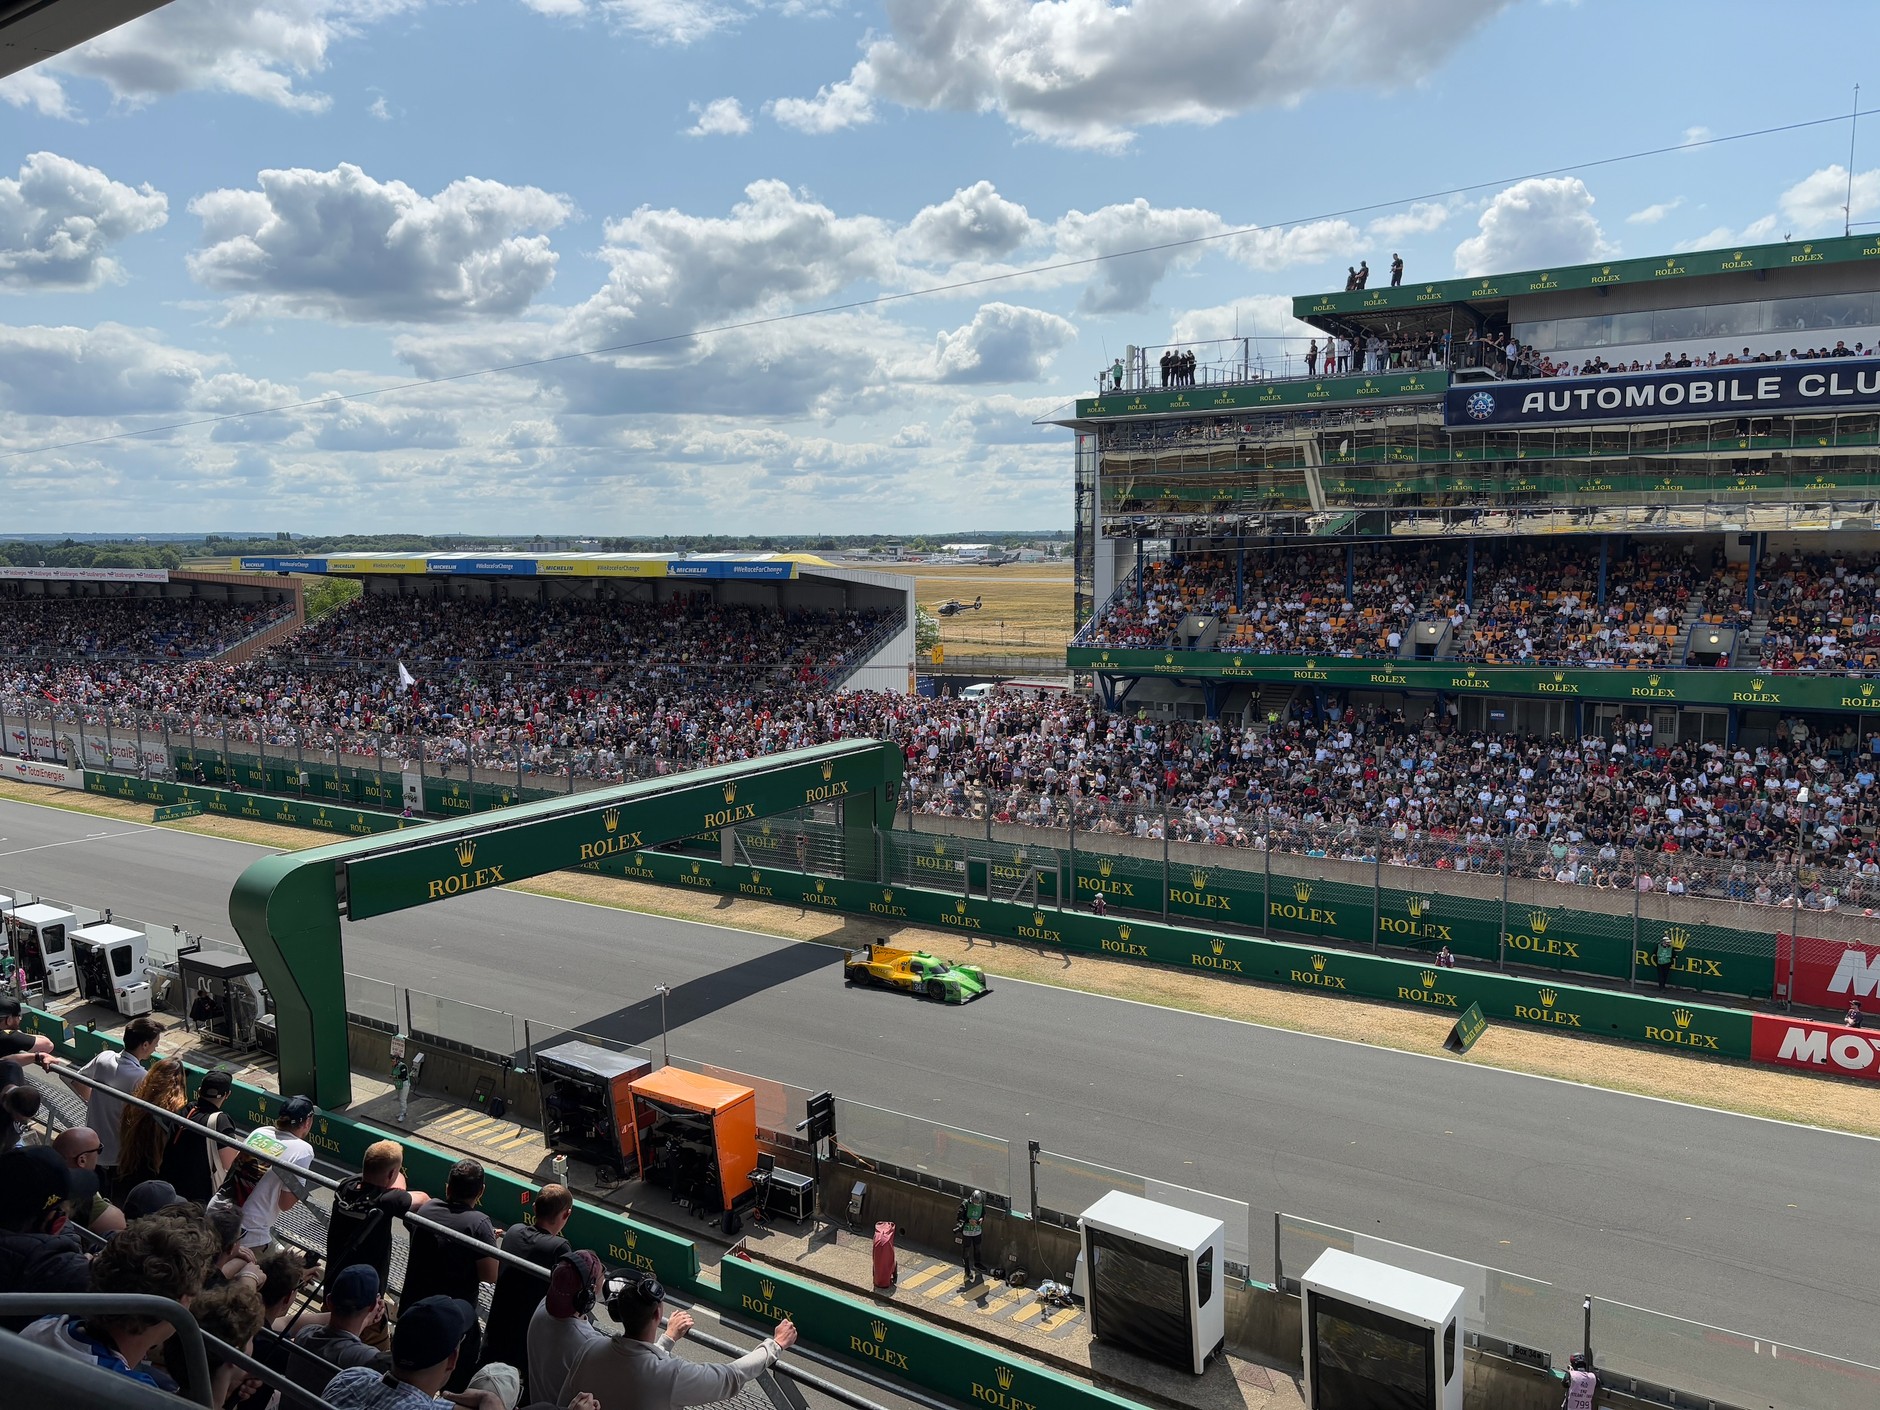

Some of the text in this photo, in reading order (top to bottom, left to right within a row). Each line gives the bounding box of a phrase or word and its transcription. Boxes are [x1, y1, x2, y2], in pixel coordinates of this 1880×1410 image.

[1792, 254, 1823, 262] ROLEX
[1522, 371, 1880, 414] AUTOMOBILE CLU
[1294, 671, 1327, 679] ROLEX
[1371, 675, 1406, 684] ROLEX
[1452, 679, 1489, 688] ROLEX
[1539, 683, 1578, 693] ROLEX
[1632, 688, 1675, 697] ROLEX
[1733, 693, 1780, 703] ROLEX
[28, 766, 65, 782] TotalEnergies
[250, 771, 270, 781] ROLX
[806, 781, 848, 802] ROLEX
[209, 802, 227, 810] ROLEX
[442, 797, 469, 808] ROLEX
[242, 807, 260, 816] ROLEX
[277, 813, 296, 821] ROLEX
[704, 804, 755, 829] ROLEX
[313, 819, 333, 827] ROLEX
[351, 824, 371, 833] ROLEX
[580, 832, 643, 861] ROLEX
[625, 866, 654, 878] ROLEX
[428, 865, 505, 898] ROLEX
[681, 875, 711, 886] ROLEX
[1078, 876, 1134, 896] ROLEX
[740, 883, 772, 896] ROLEX
[802, 893, 837, 905] ROLEX
[1170, 889, 1230, 910] ROLEX
[870, 903, 906, 916] ROLEX
[1270, 903, 1337, 924] ROLEX
[942, 913, 980, 928] ROLEX
[1018, 926, 1060, 942] ROLEX
[1379, 917, 1452, 940] ROLEX
[1101, 940, 1147, 956] ROLEX
[1503, 931, 1579, 957] ROLEX
[1192, 954, 1242, 972] ROLEX
[1290, 970, 1345, 989] ROLEX
[1398, 987, 1457, 1007] ROLEX
[1514, 1004, 1581, 1026] ROLEX
[1645, 1025, 1718, 1049] ROLEX
[308, 1132, 340, 1152] ROLEX
[609, 1244, 654, 1272] ROLEX
[851, 1336, 908, 1370] ROLEX
[1515, 1345, 1536, 1358] Box 34
[1575, 1400, 1589, 1408] 799
